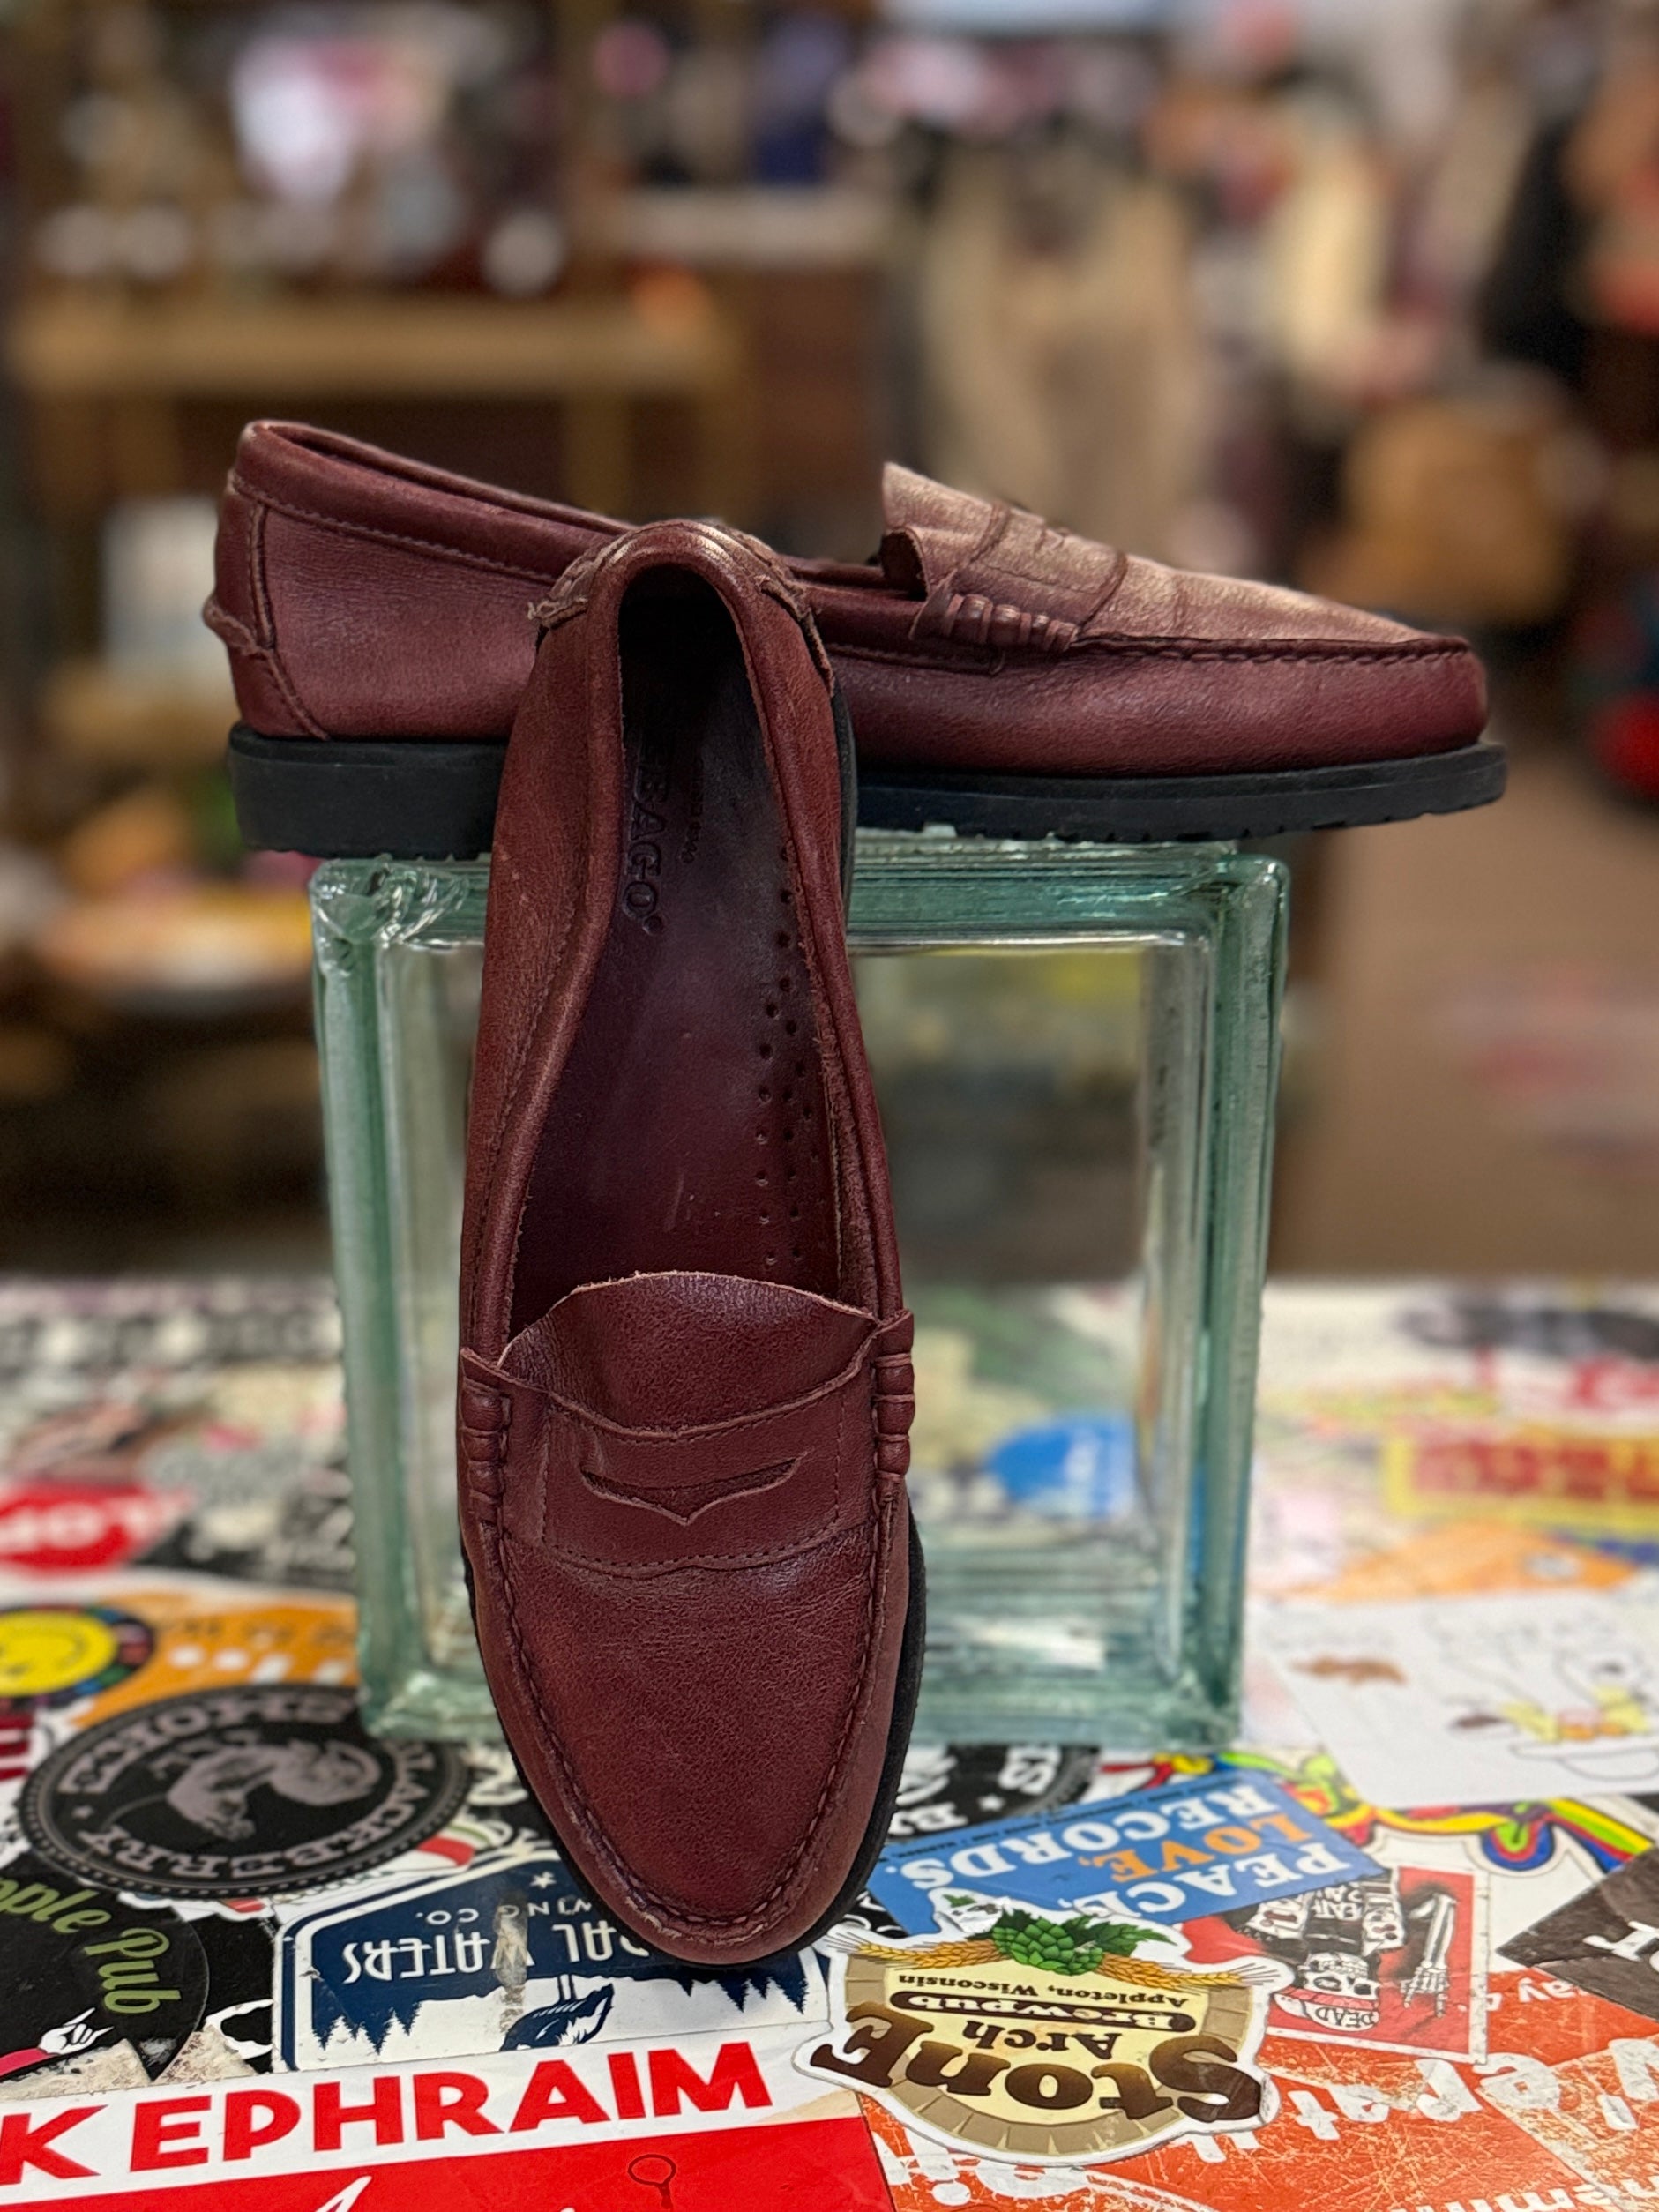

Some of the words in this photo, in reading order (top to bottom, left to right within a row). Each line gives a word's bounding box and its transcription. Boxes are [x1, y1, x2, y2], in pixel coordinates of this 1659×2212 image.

[885, 1785, 1279, 1889] RECORDS.
[1079, 1814, 1313, 1882] LOVE,
[415, 1908, 479, 1925] CO.
[83, 1927, 182, 2014] Pub
[899, 1975, 1039, 1996] Wisconsin
[908, 1996, 1175, 2029] Brewpub
[1048, 1985, 1189, 2007] Appleton,
[1314, 2006, 1376, 2028] DEAD
[962, 2021, 1123, 2059] Arch
[130, 2041, 772, 2172] EPHRAIM
